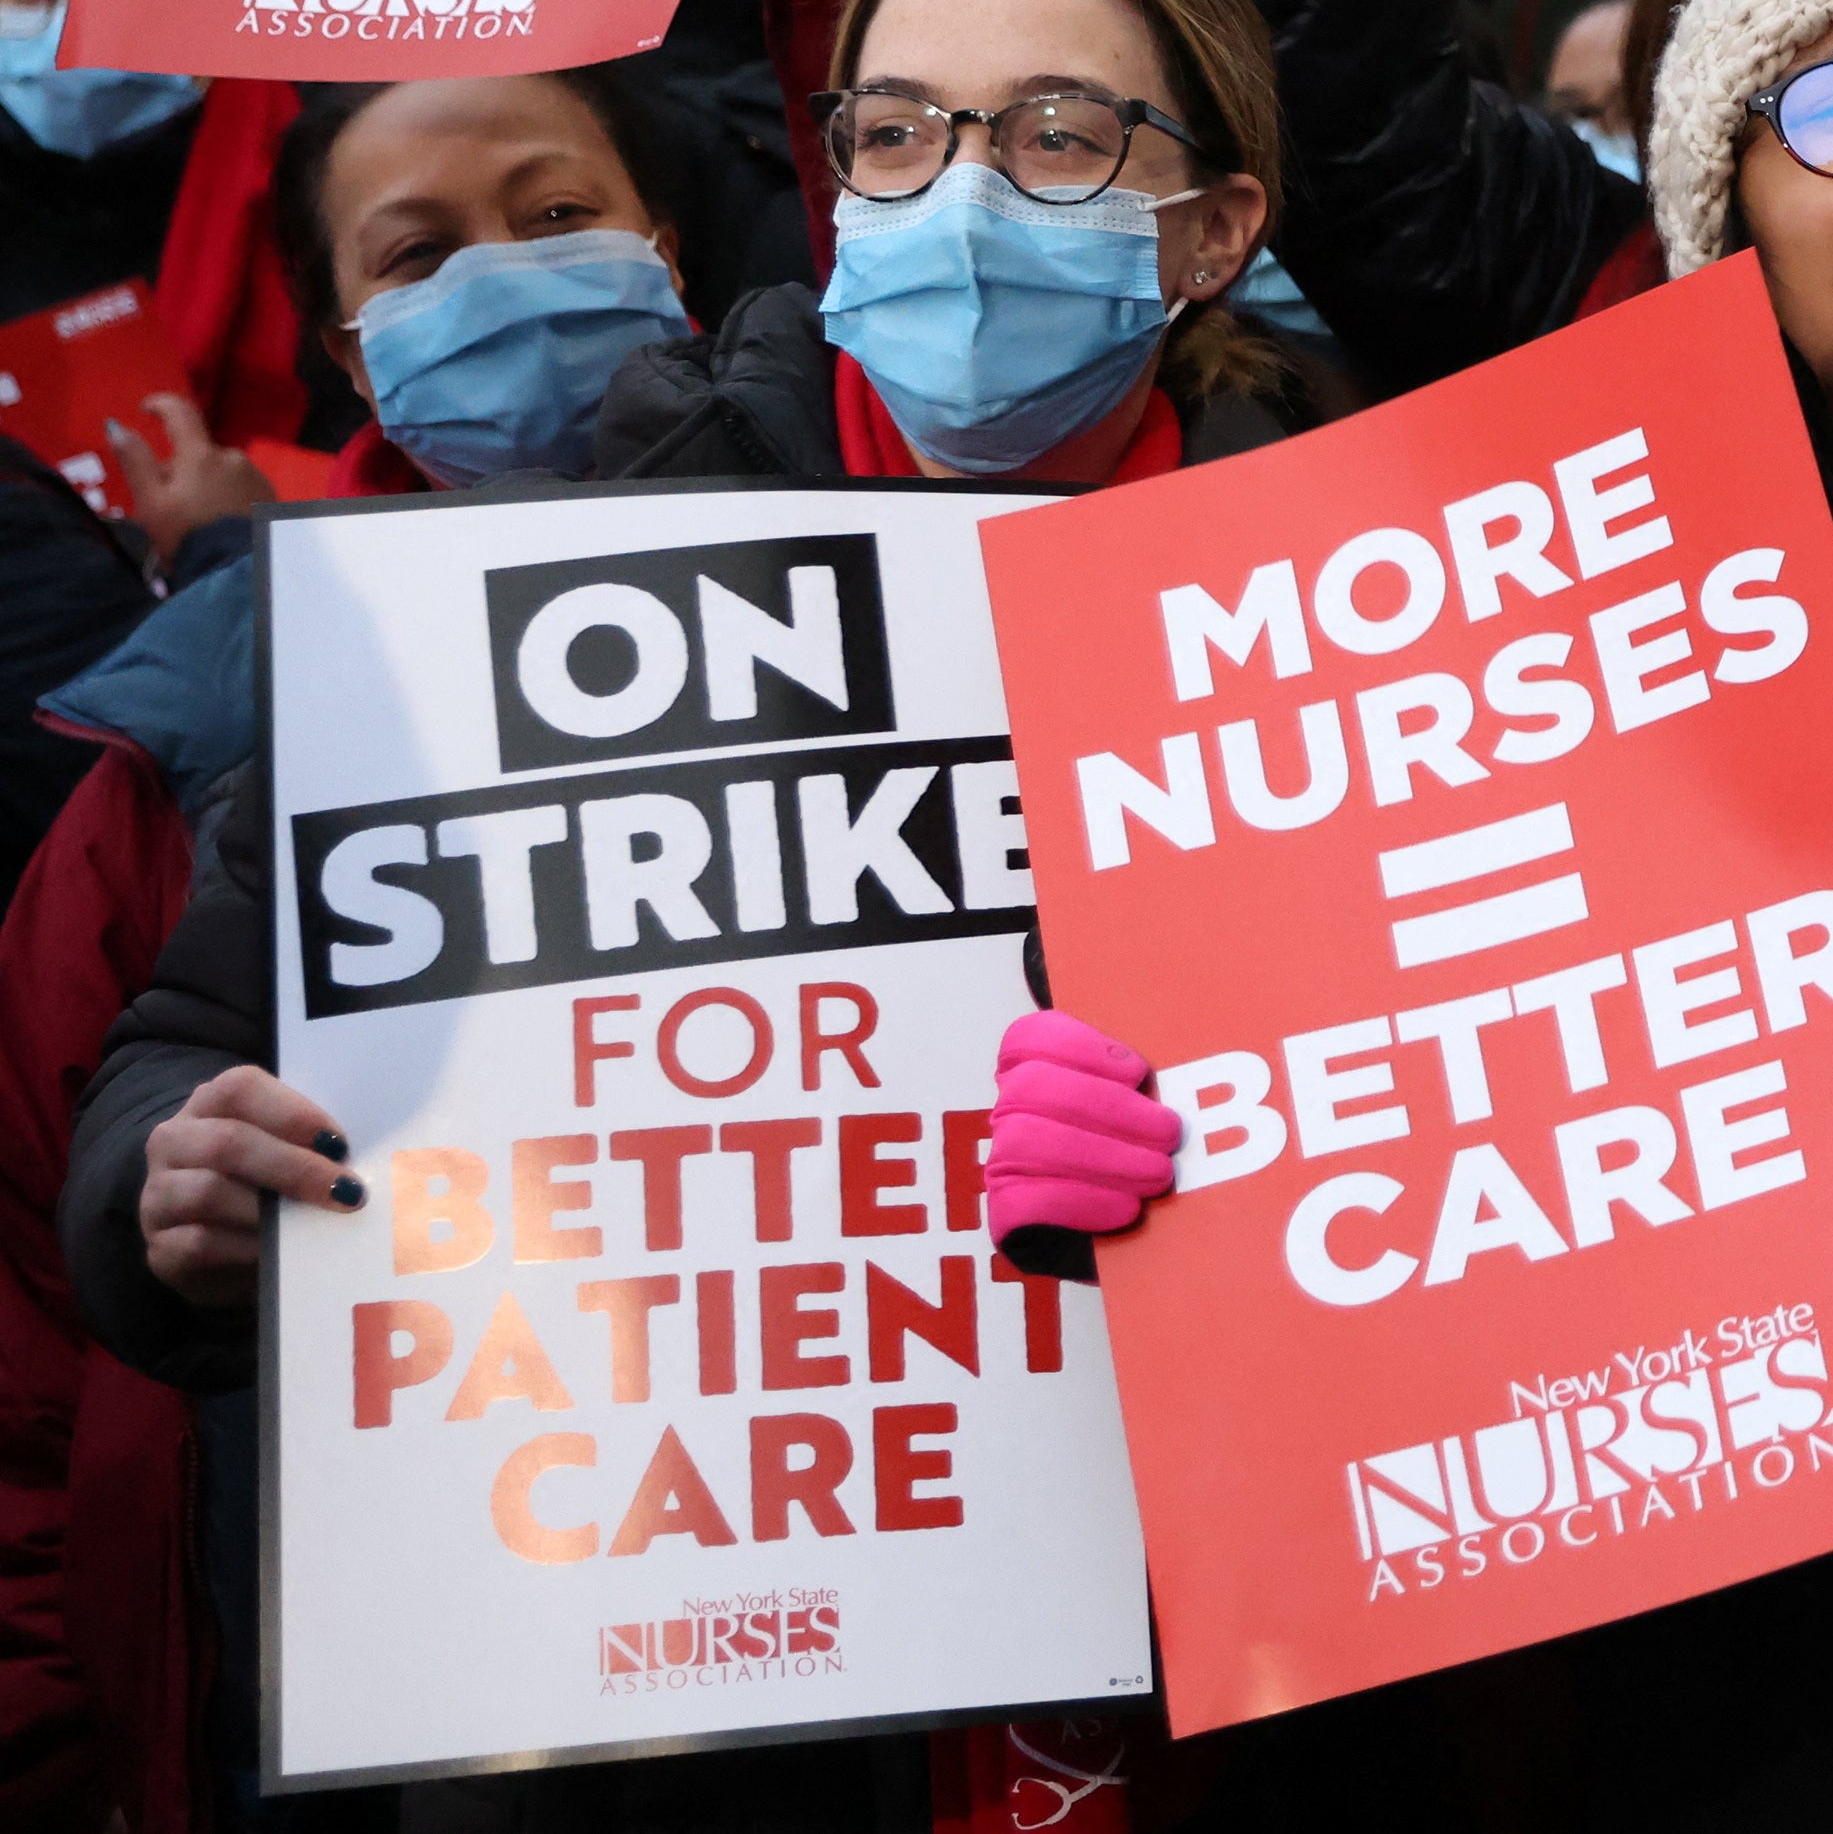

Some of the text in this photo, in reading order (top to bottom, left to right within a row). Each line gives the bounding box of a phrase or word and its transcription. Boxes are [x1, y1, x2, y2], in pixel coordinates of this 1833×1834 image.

[235, 7, 534, 39] ASSOCIATION
[1159, 427, 1674, 703] MORE
[518, 563, 850, 740] ON
[1074, 545, 1812, 873] NURSES
[318, 762, 1033, 989] STRIKE
[571, 979, 879, 1108] FOR
[1285, 1059, 1810, 1309] CARE
[352, 1252, 1064, 1432] PATIENT
[1510, 1301, 1816, 1419] New York State
[490, 1402, 964, 1565] CARE
[599, 1606, 840, 1676] NURSES
[600, 1654, 843, 1696] ASSOCIATION
[683, 1587, 839, 1616] New York State
